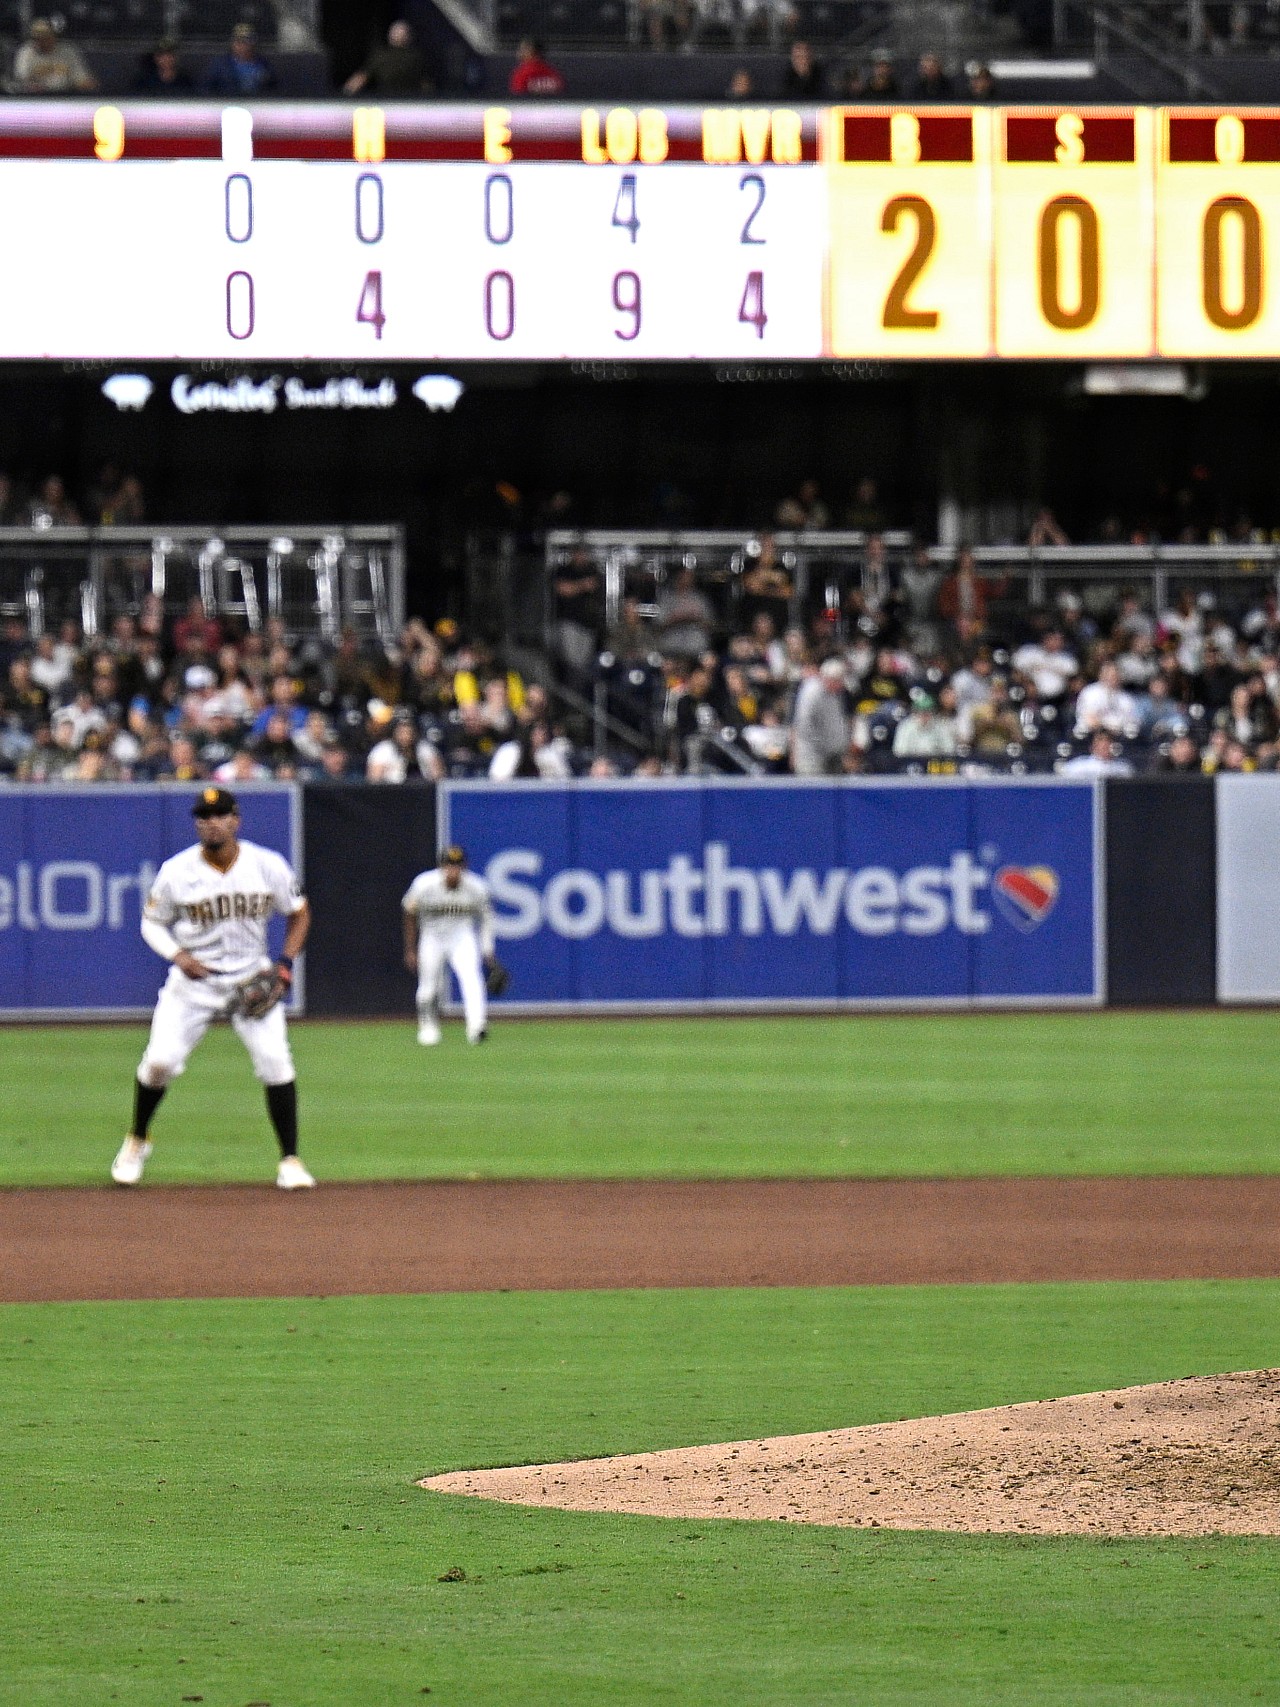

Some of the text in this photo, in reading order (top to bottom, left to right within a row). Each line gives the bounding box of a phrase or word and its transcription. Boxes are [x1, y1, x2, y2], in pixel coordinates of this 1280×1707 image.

[484, 107, 513, 163] E
[581, 107, 669, 164] LOB
[1055, 112, 1085, 165] S
[225, 172, 767, 245] 0 0 0 4 2
[881, 194, 1262, 330] 2 0 0
[226, 270, 768, 341] 0 4 0 9 4
[484, 842, 991, 940] Southwest
